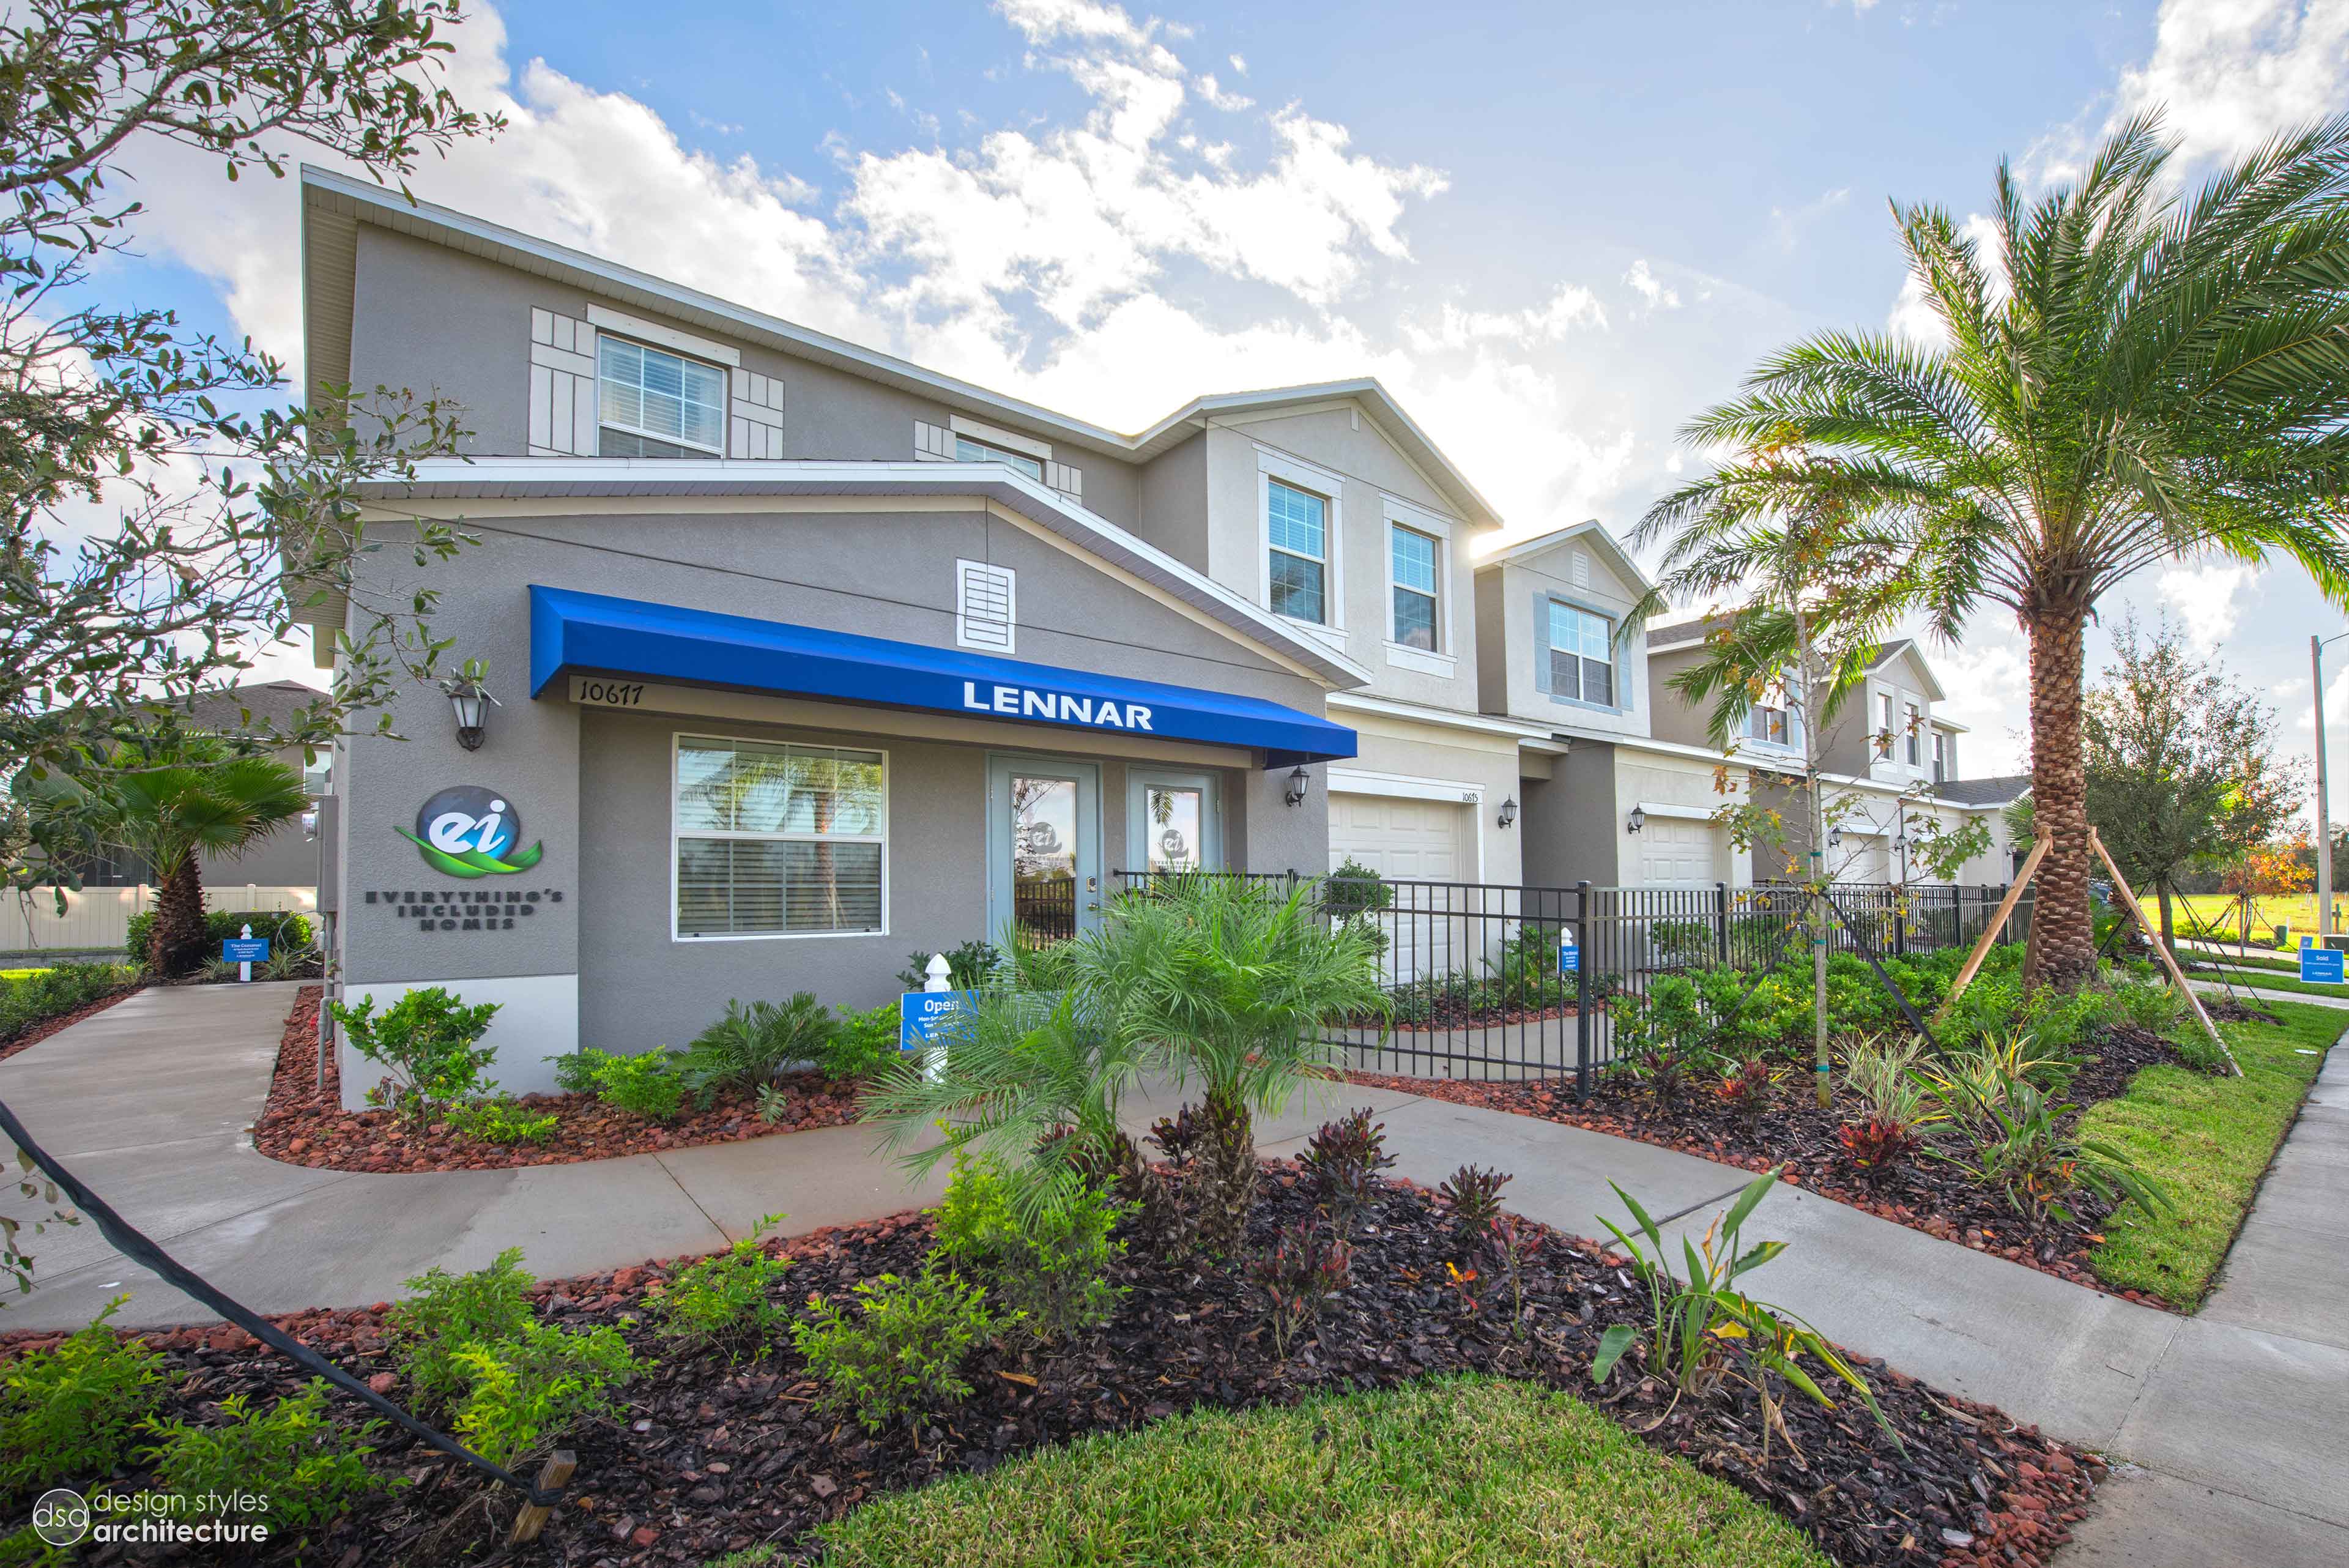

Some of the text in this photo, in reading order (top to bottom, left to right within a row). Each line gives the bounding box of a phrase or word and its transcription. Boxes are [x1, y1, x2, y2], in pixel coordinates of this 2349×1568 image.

[580, 680, 644, 705] 10677
[963, 681, 1154, 730] LENNAR
[1463, 792, 1479, 803] 10675
[429, 800, 505, 853] ei
[365, 888, 563, 904] EVERYTHING'S
[398, 905, 534, 917] INCLUDED
[421, 918, 514, 931] HOMES
[924, 999, 959, 1014] Open
